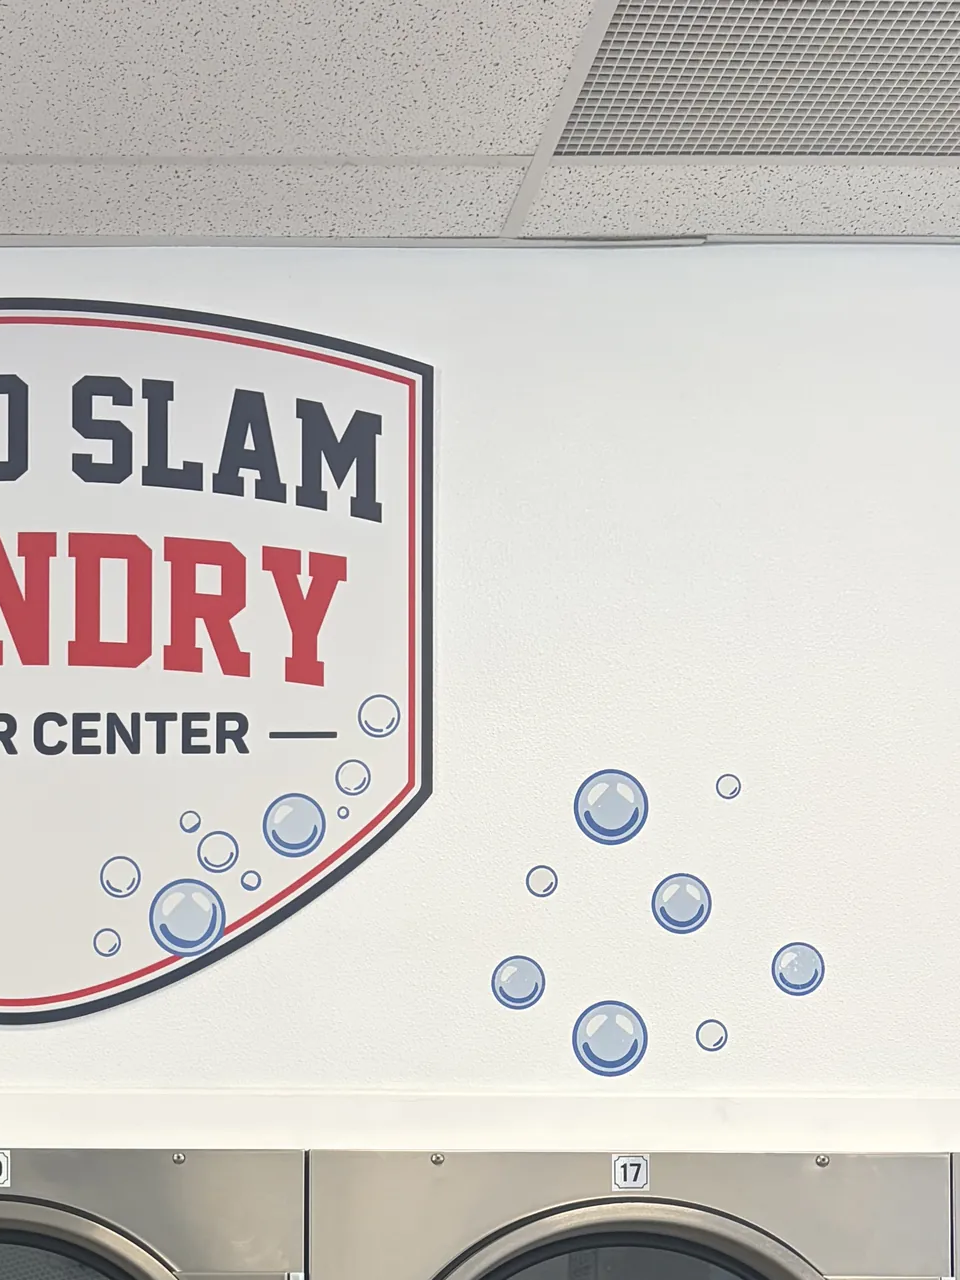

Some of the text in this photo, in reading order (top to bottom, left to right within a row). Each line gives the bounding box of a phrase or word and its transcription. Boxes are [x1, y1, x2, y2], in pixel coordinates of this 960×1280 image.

[71, 375, 383, 523] SLAM
[33, 711, 250, 756] CENTER
[620, 1163, 642, 1182] 17
